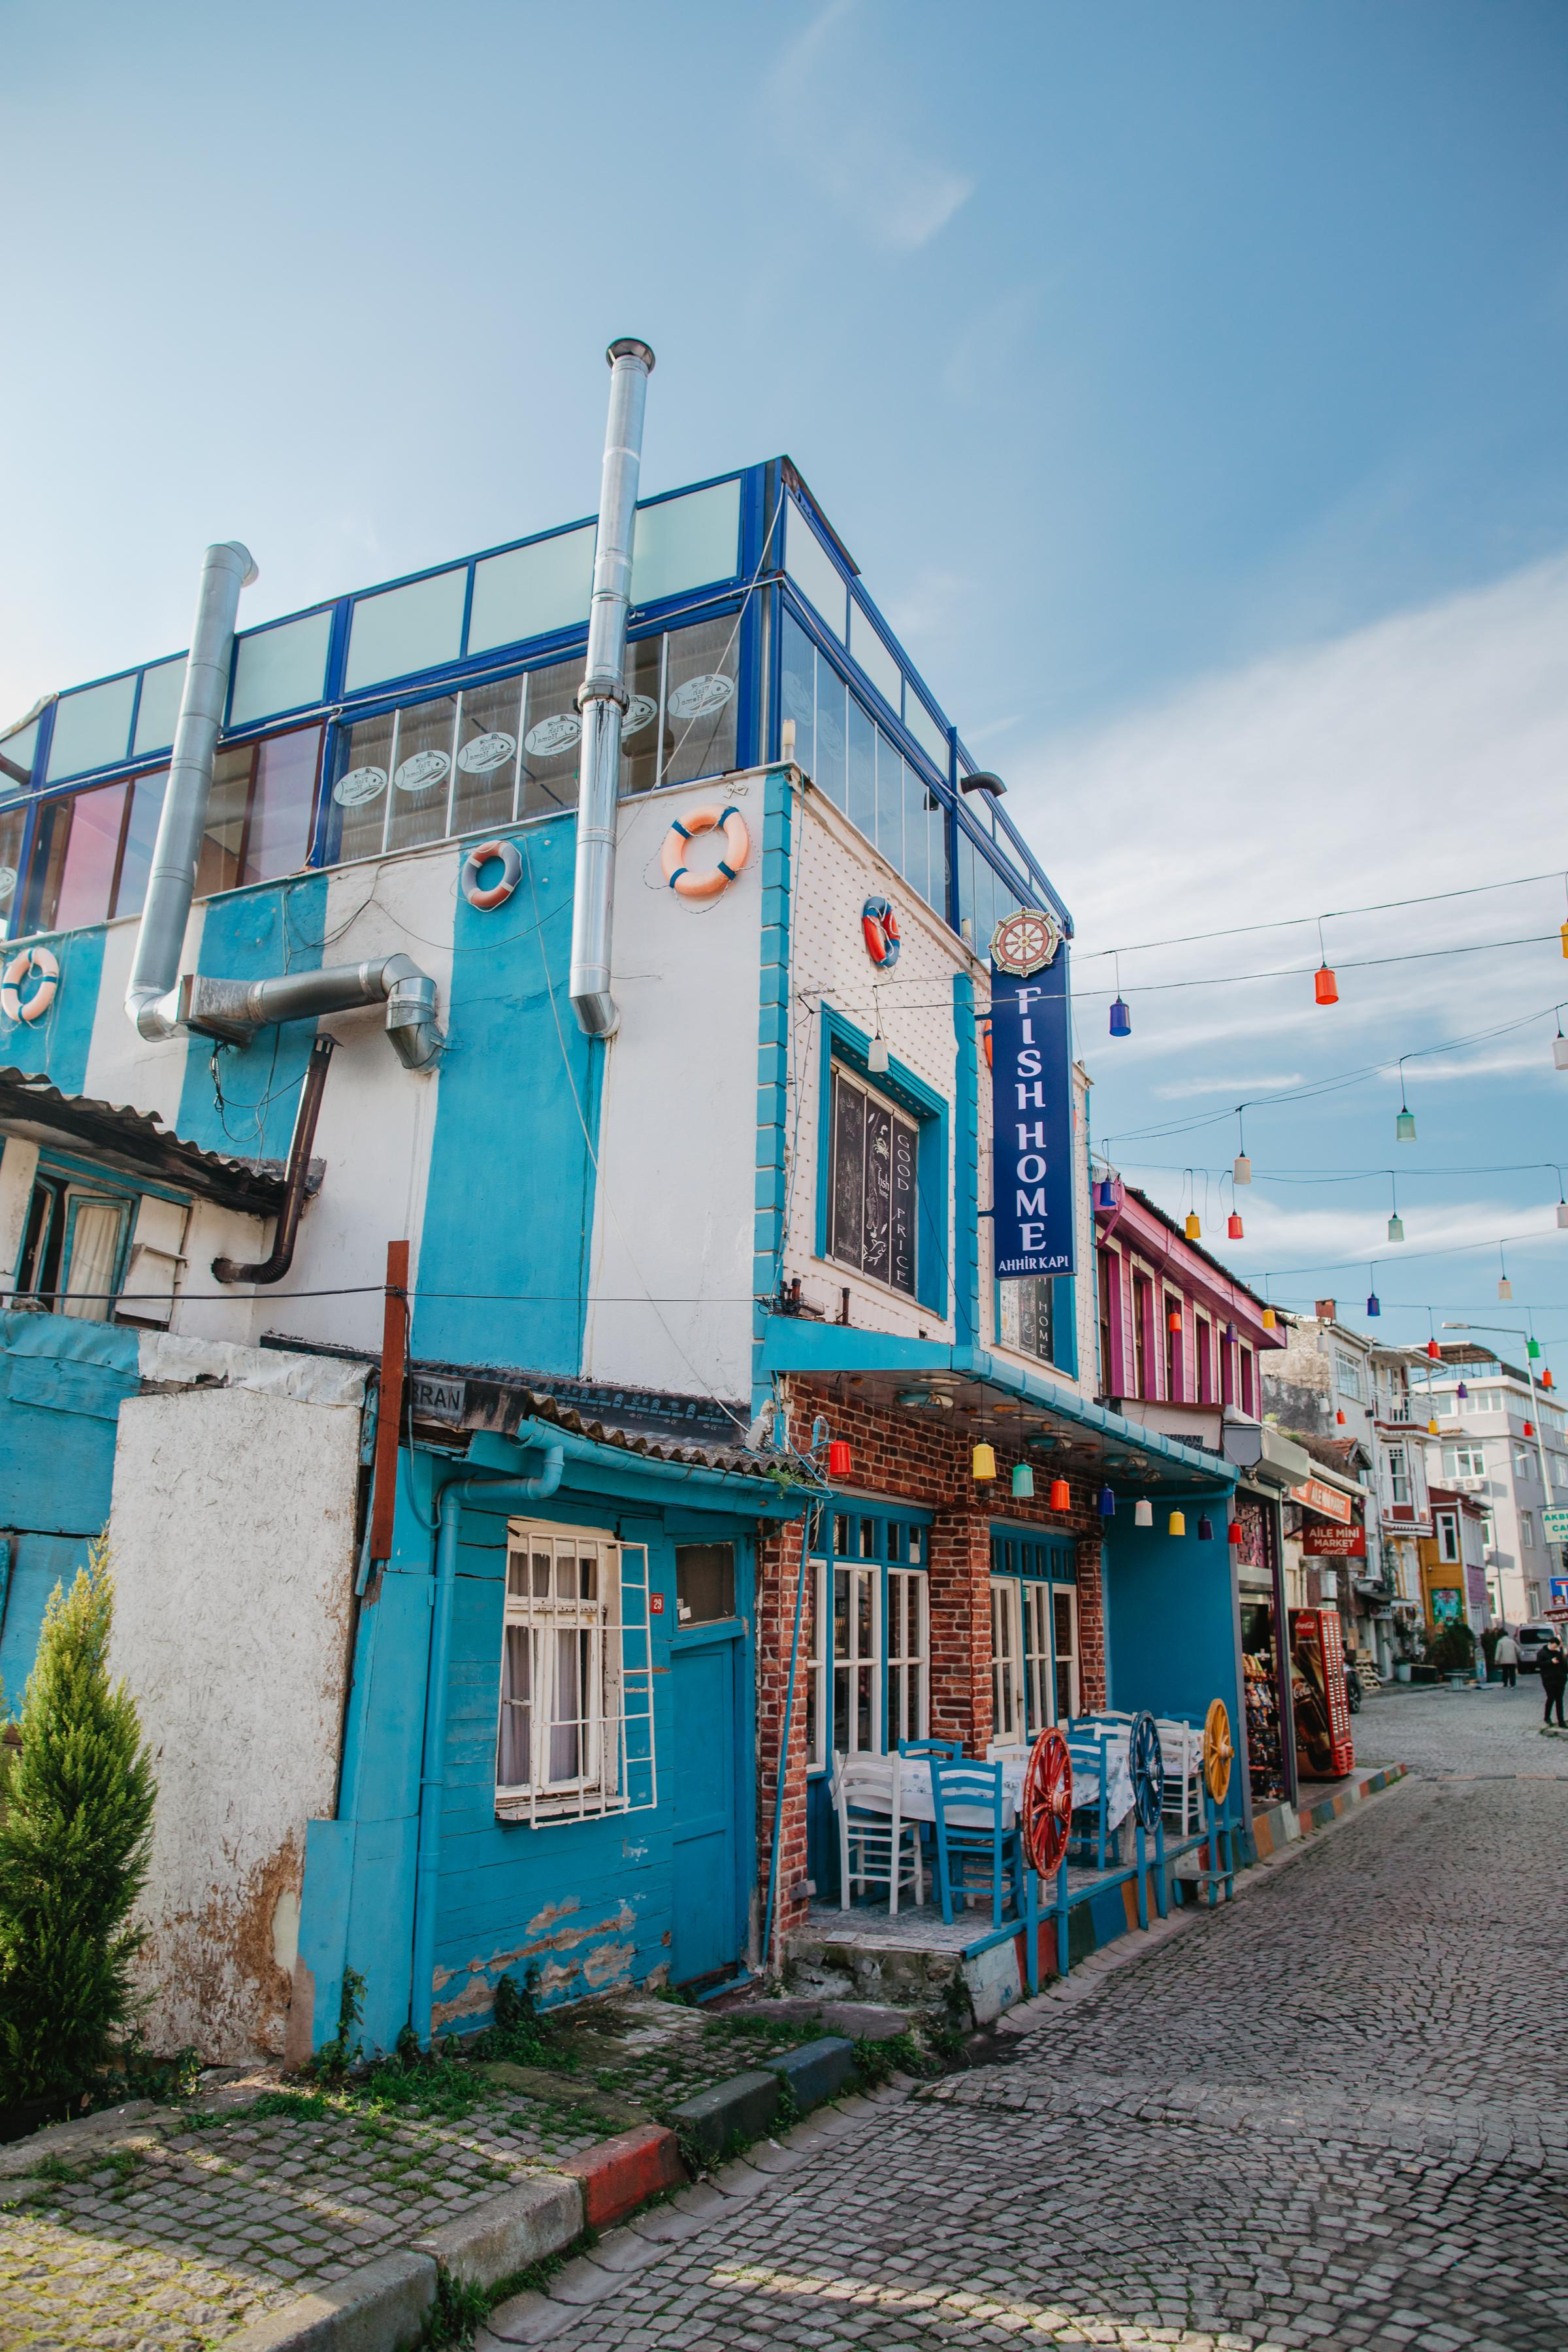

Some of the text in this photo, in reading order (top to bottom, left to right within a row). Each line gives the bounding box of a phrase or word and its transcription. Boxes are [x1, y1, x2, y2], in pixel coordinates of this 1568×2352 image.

[1015, 987, 1047, 1251] FISH HOME
[896, 1135, 910, 1285] GOOD PRICE
[1039, 1255, 1069, 1268] KAPI
[1309, 1527, 1360, 1538] AİLE MİNİ
